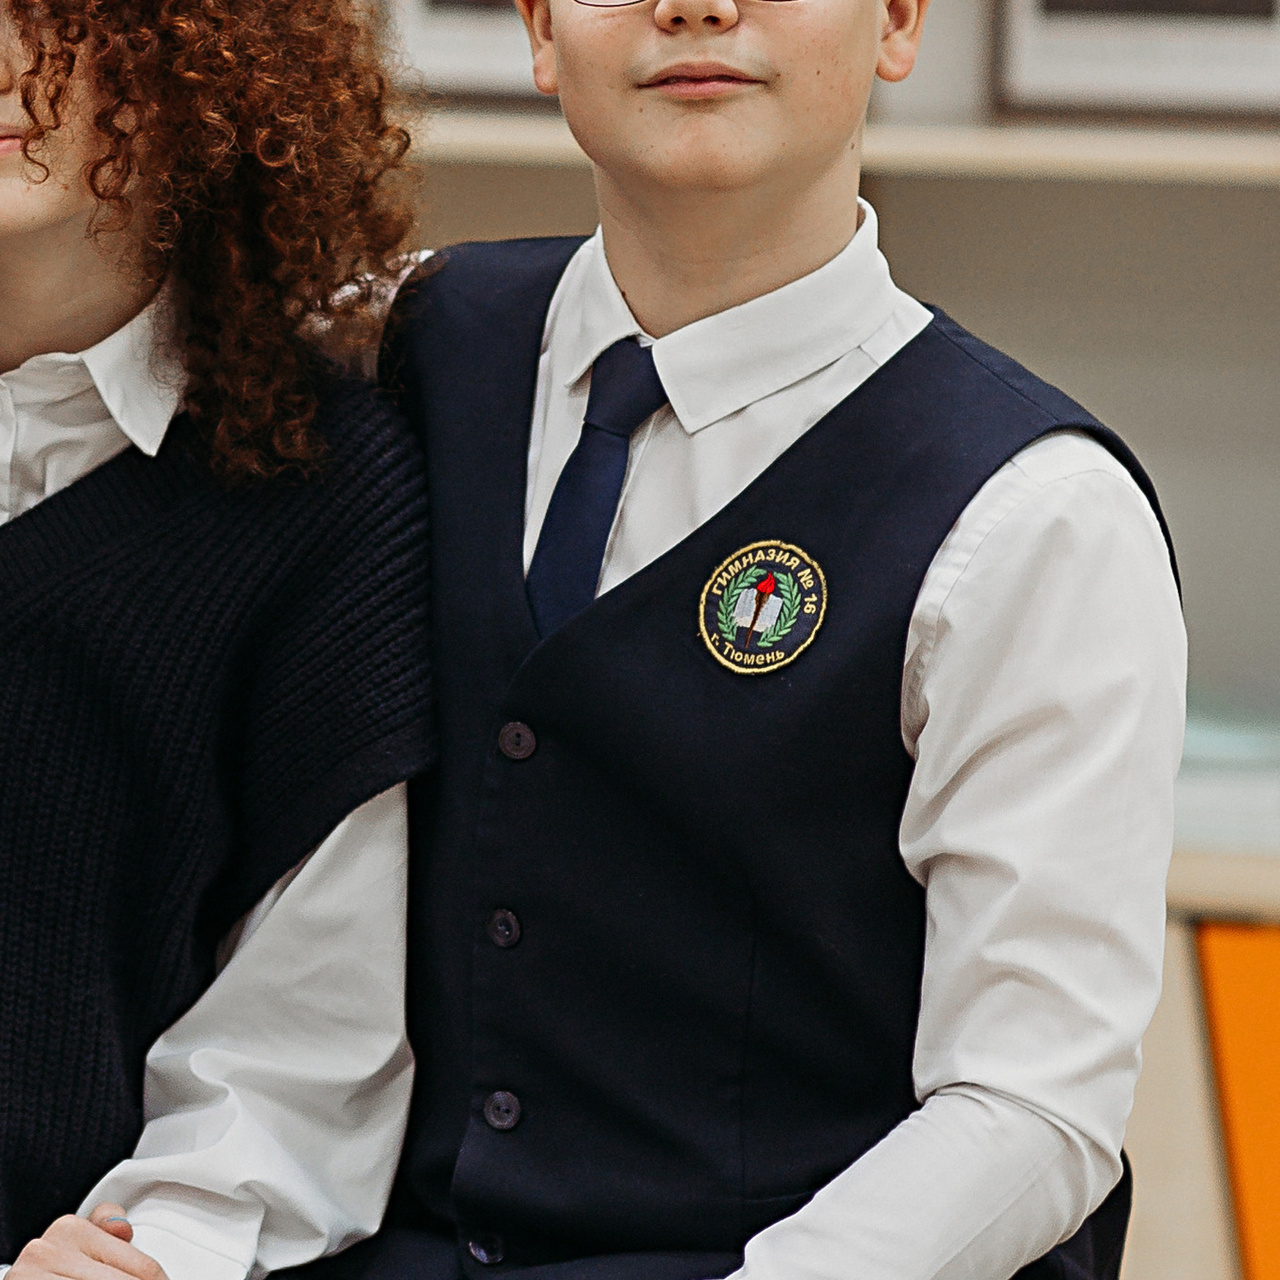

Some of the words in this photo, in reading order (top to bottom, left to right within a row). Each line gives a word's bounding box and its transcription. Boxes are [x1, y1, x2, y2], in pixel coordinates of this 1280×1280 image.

[712, 548, 800, 596] ГИМНАЗИЯ
[804, 593, 818, 614] 16
[710, 633, 720, 646] г.
[722, 642, 785, 665] Тюмень
